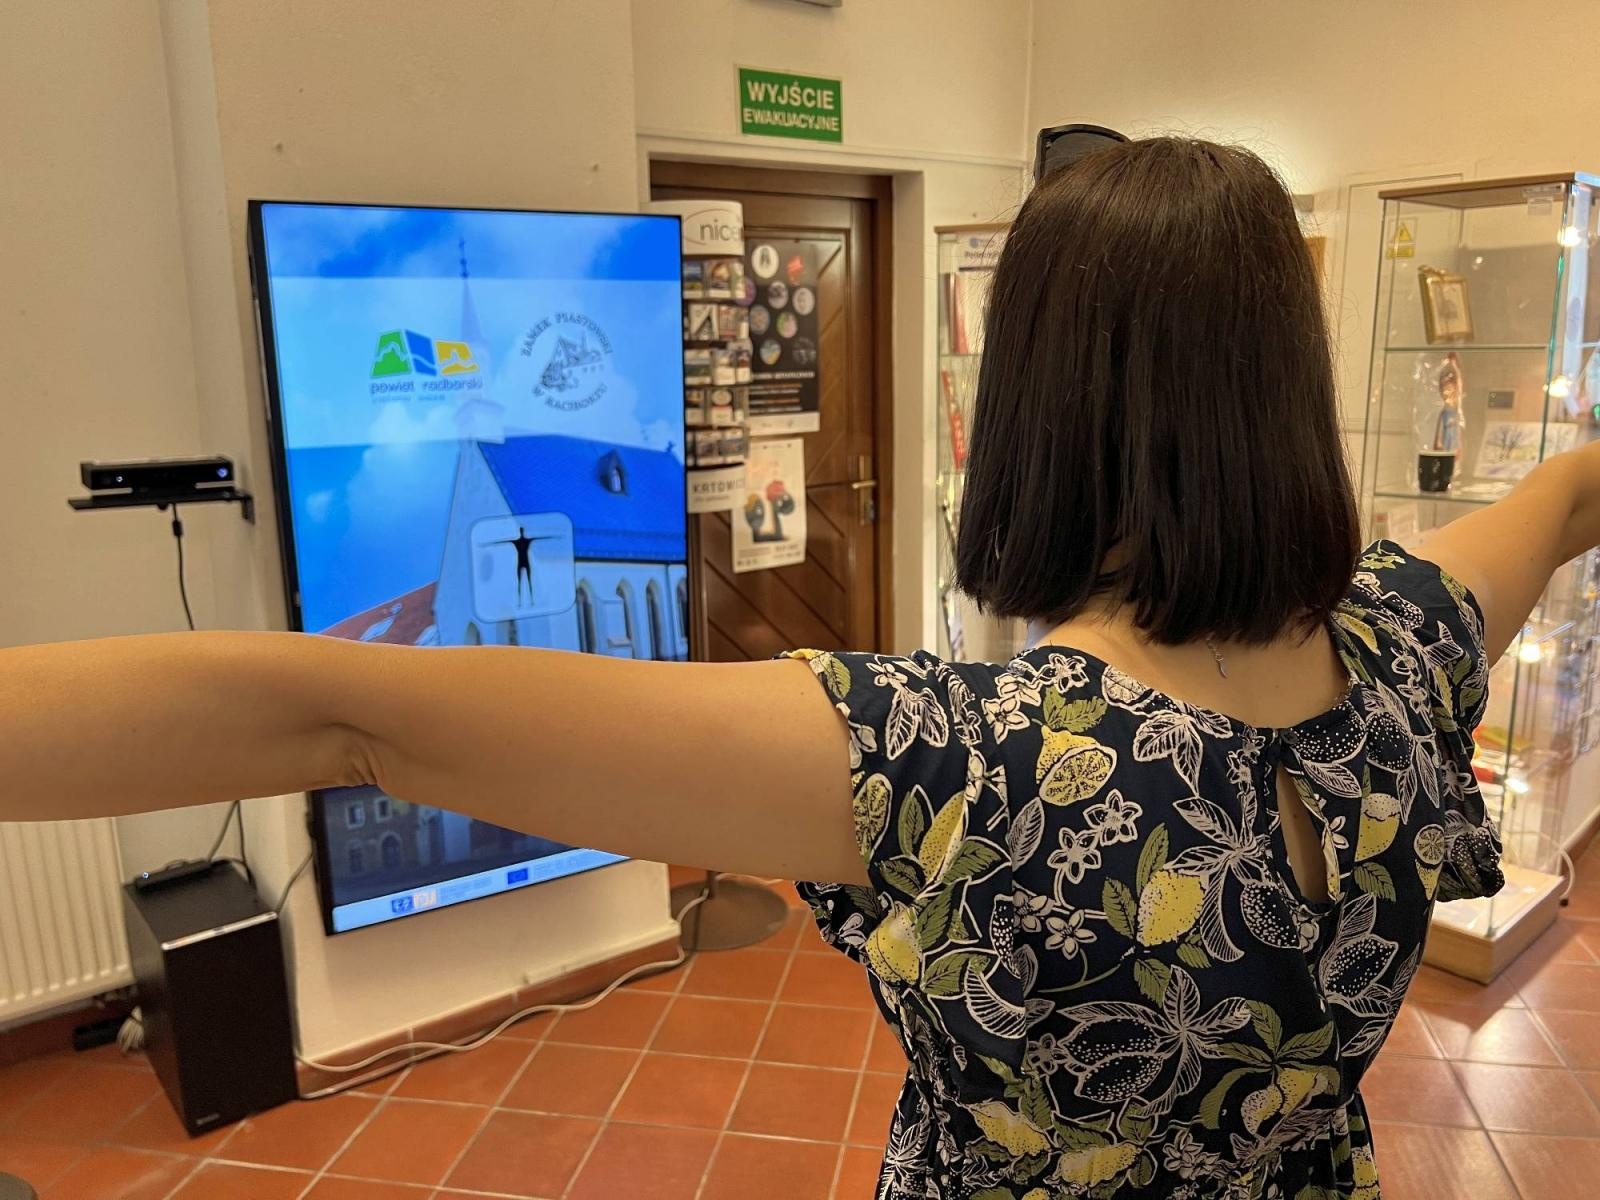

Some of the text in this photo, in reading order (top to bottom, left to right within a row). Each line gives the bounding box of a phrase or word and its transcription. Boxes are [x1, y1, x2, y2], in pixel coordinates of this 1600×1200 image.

[746, 80, 835, 110] WYJŚCIE
[743, 107, 840, 132] EWAKUACYJNE
[370, 380, 415, 395] powiat
